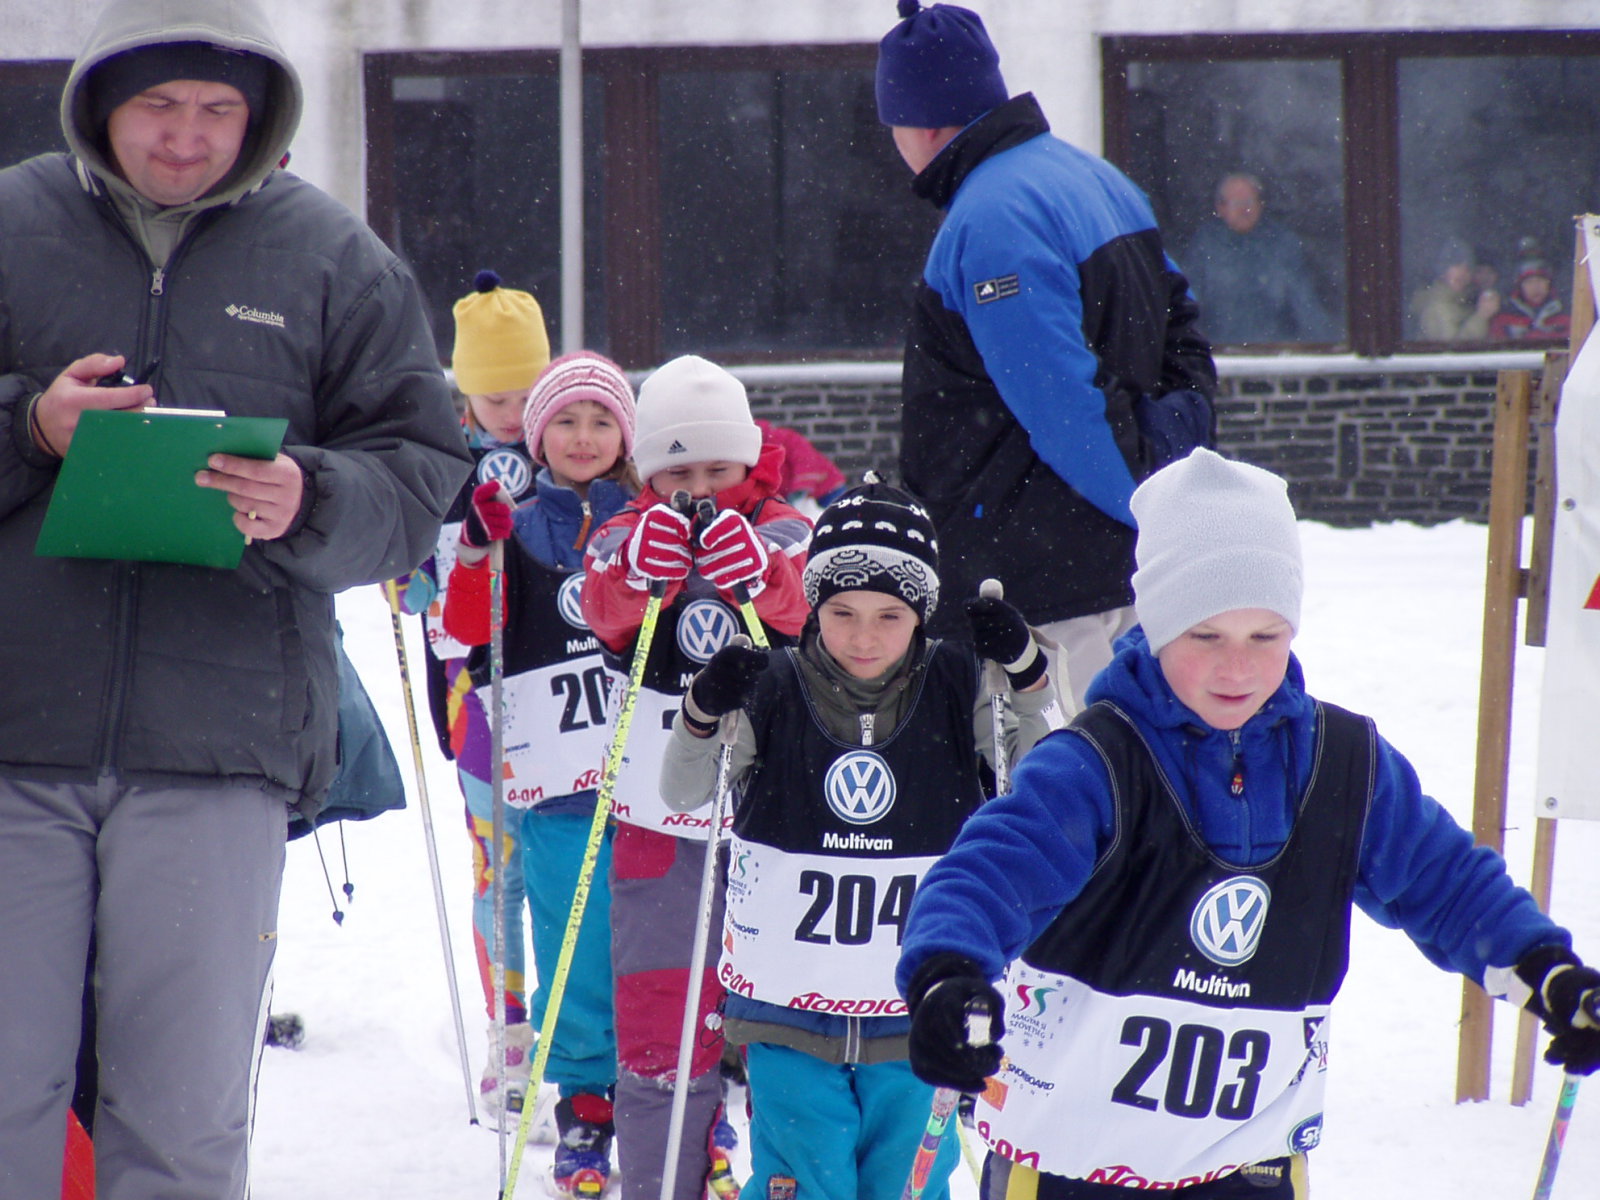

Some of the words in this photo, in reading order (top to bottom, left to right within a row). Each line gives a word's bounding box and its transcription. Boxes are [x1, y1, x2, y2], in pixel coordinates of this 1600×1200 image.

[239, 305, 285, 323] Columbia
[550, 665, 608, 733] 20
[822, 833, 893, 850] Multivan
[795, 869, 917, 946] 204
[1111, 1015, 1271, 1121] 203
